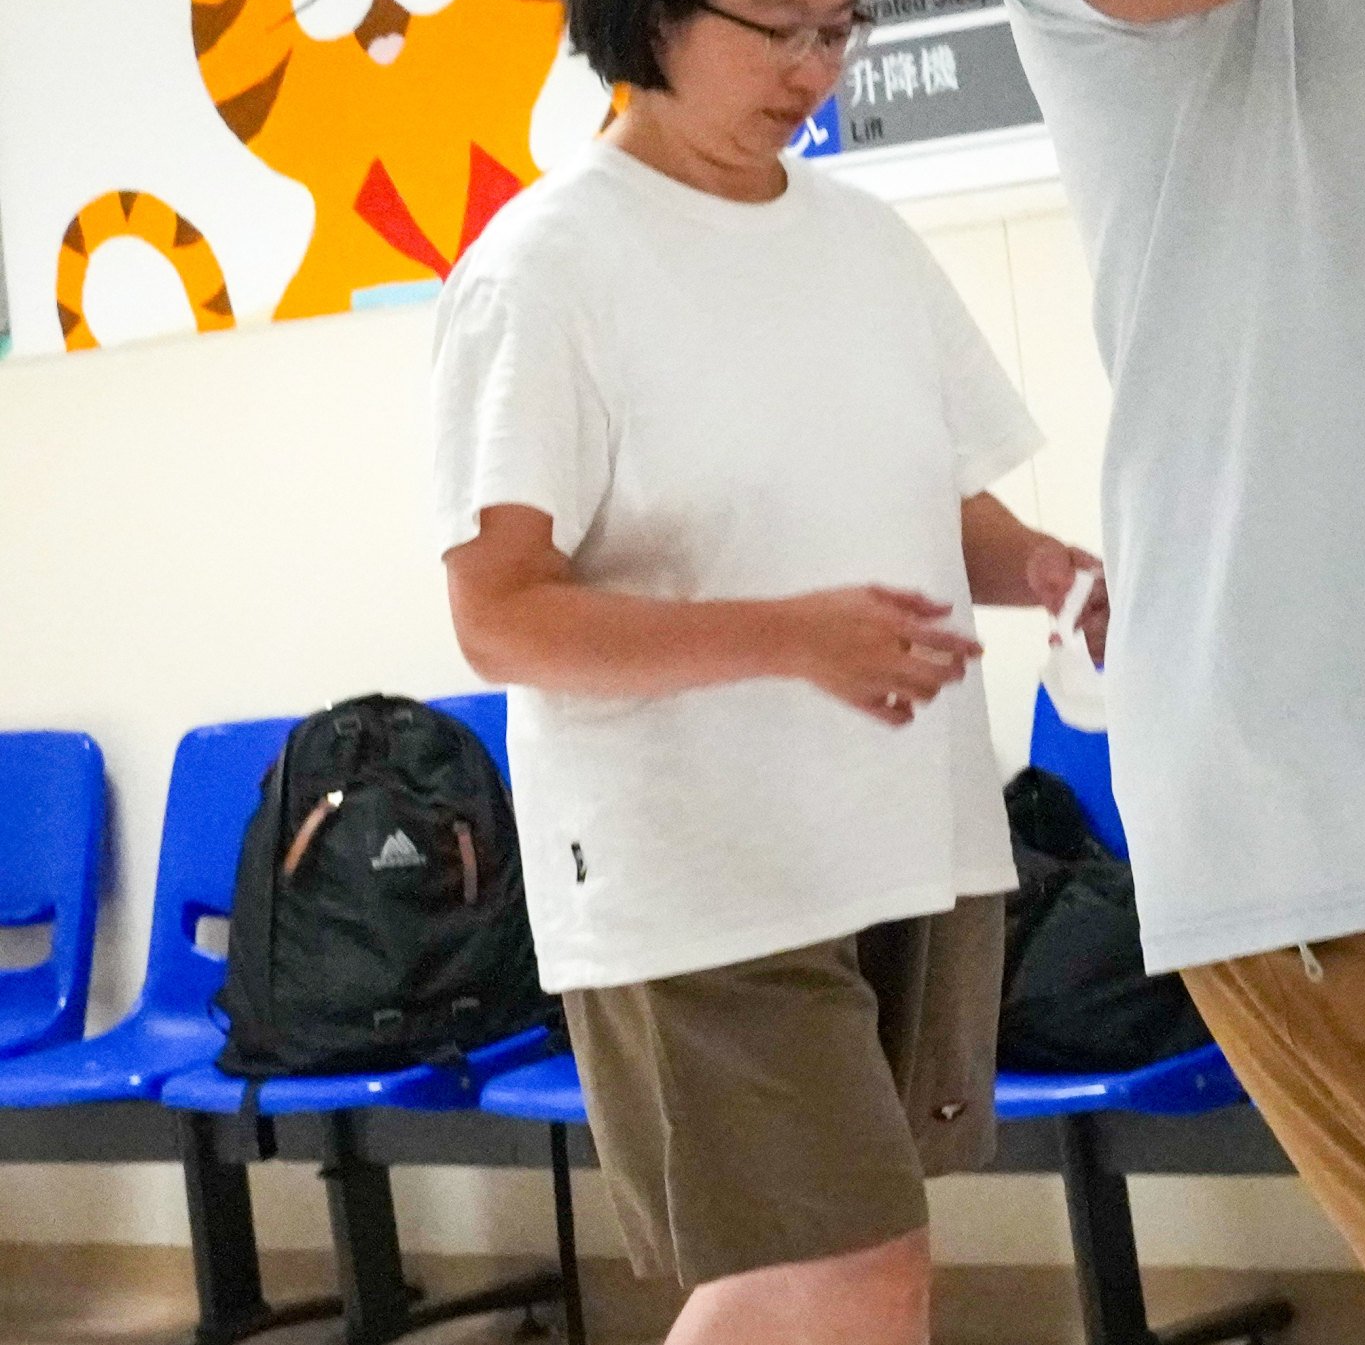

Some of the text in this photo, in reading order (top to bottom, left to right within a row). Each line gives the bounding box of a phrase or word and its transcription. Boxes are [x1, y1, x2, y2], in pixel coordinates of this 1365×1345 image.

[847, 44, 960, 107] 升降機
[851, 117, 884, 143] Lift
